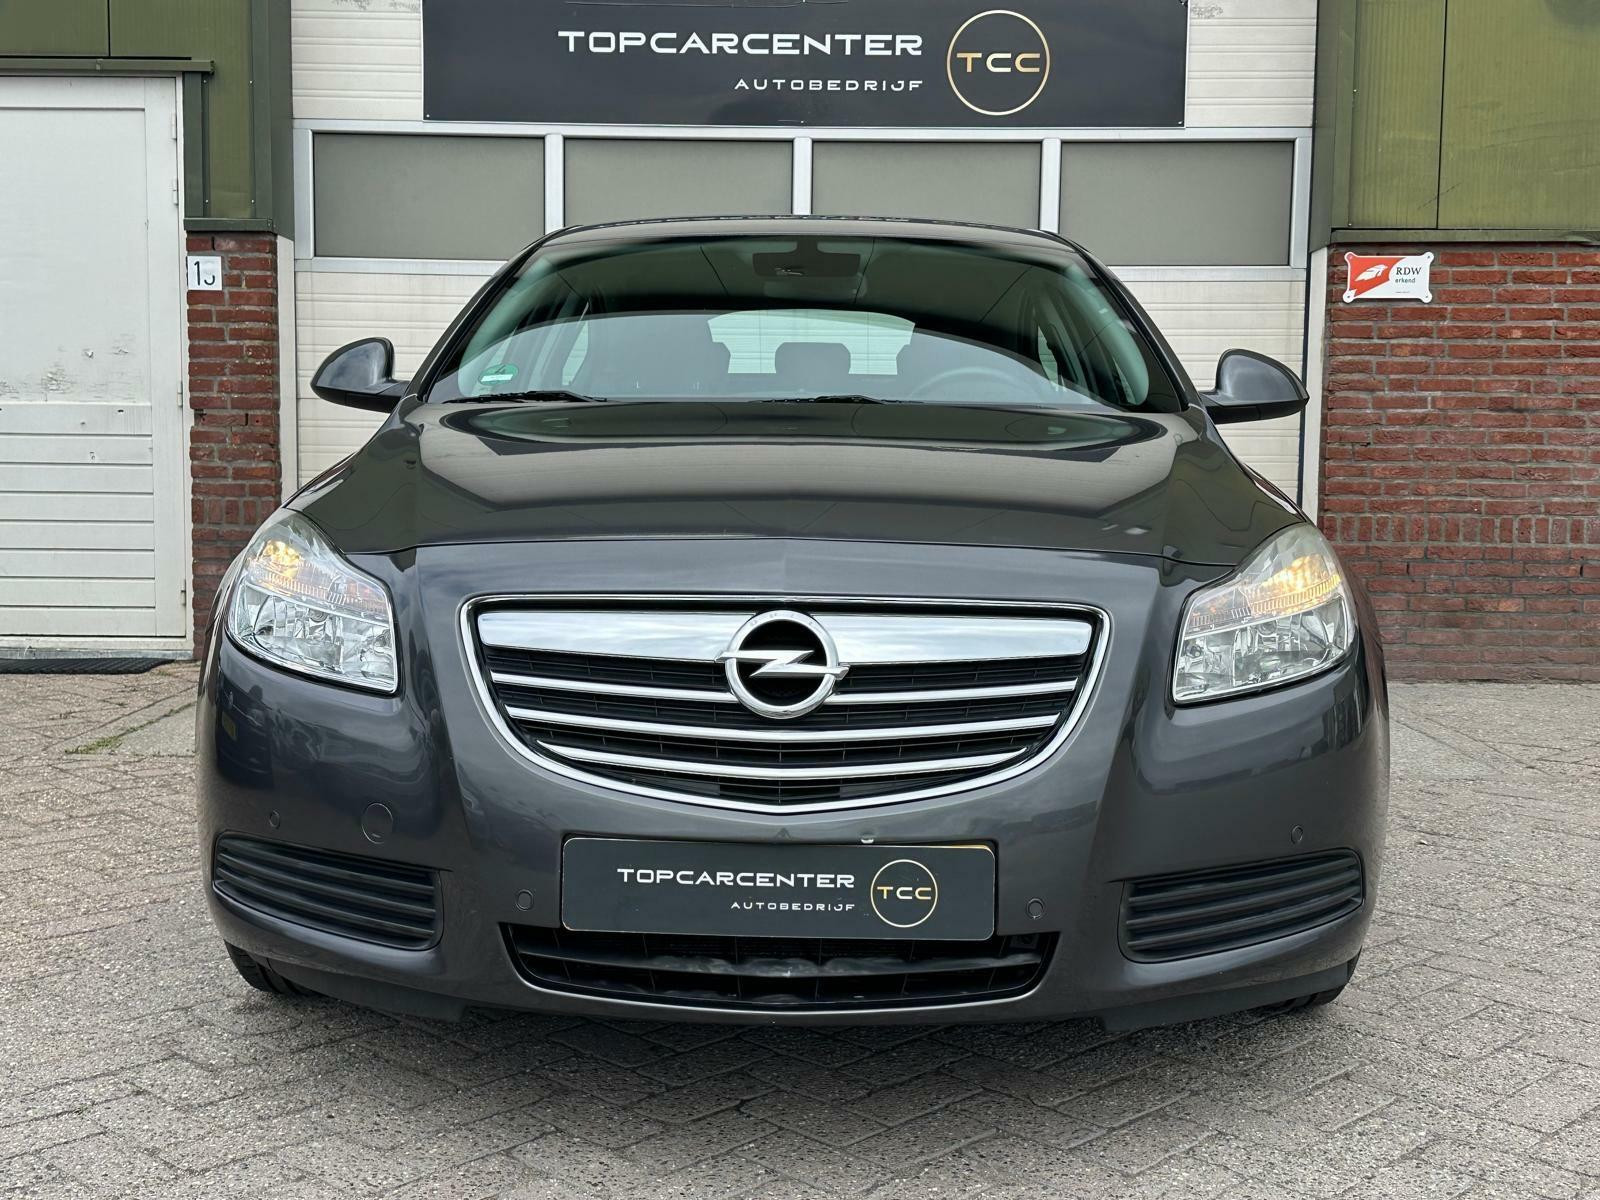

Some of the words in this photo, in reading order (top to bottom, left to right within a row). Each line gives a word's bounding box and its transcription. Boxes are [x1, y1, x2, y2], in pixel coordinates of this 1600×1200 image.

[558, 31, 922, 55] TOPCARCENTER
[957, 53, 1040, 72] TCC
[734, 79, 922, 91] AUTOBEDRIJF
[1396, 266, 1422, 276] RDW
[617, 869, 854, 888] TOPCARCENTER
[877, 887, 931, 899] TCC
[731, 902, 855, 911] AUTOBEDRIJF
